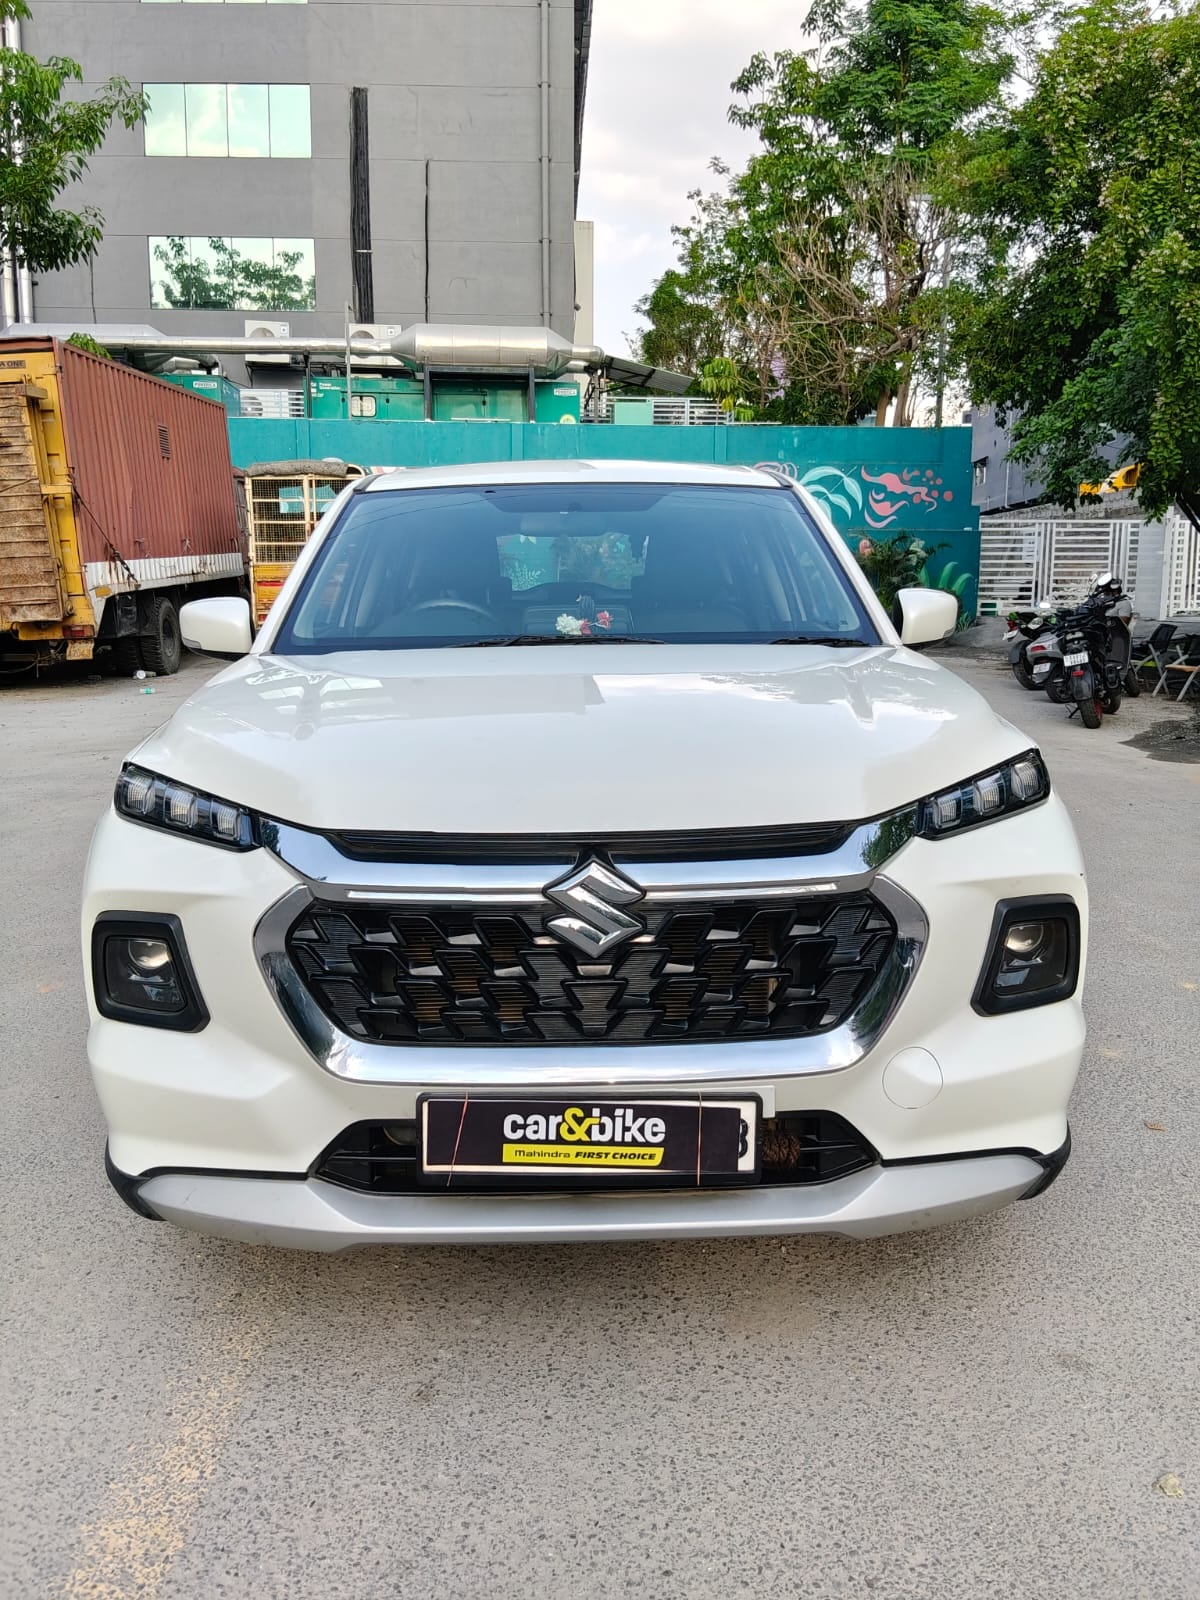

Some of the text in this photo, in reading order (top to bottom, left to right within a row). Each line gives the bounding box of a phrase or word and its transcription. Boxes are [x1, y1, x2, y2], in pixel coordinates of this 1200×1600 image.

[503, 1107, 666, 1143] car&bike
[514, 1150, 656, 1161] Mahindra FIRST CHOICE
